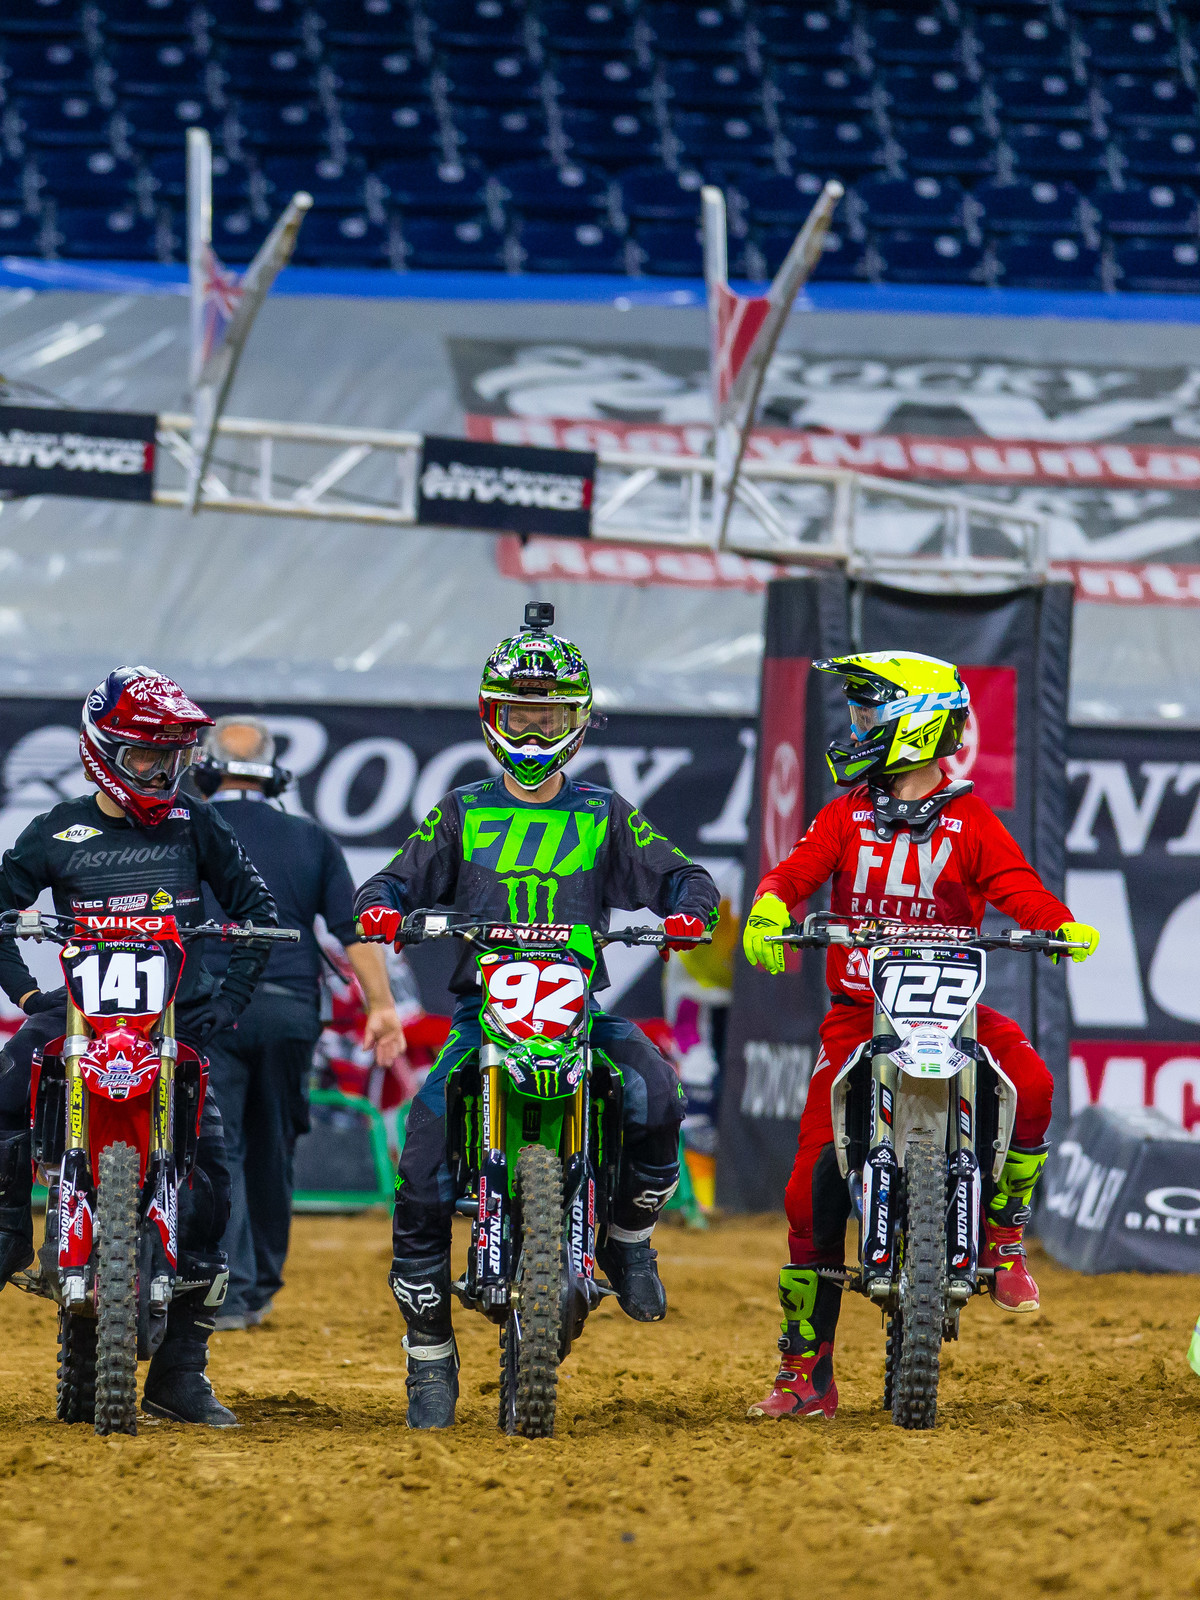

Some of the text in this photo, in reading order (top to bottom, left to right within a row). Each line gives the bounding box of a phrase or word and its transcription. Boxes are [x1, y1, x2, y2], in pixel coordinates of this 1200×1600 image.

[64, 828, 90, 839] BOLT
[462, 807, 608, 877] FOX
[852, 827, 953, 900] FLY
[851, 896, 937, 919] RACING
[105, 941, 146, 949] MONSTER
[489, 928, 571, 941] RENTHA
[882, 925, 970, 939] RENTHAL
[521, 950, 562, 959] MONSTER
[72, 952, 166, 1017] 141
[488, 961, 588, 1026] 92
[881, 965, 979, 1016] 122
[71, 1108, 82, 1139] TECH
[876, 1169, 890, 1246] DULOP
[489, 1190, 502, 1276] DNLOP
